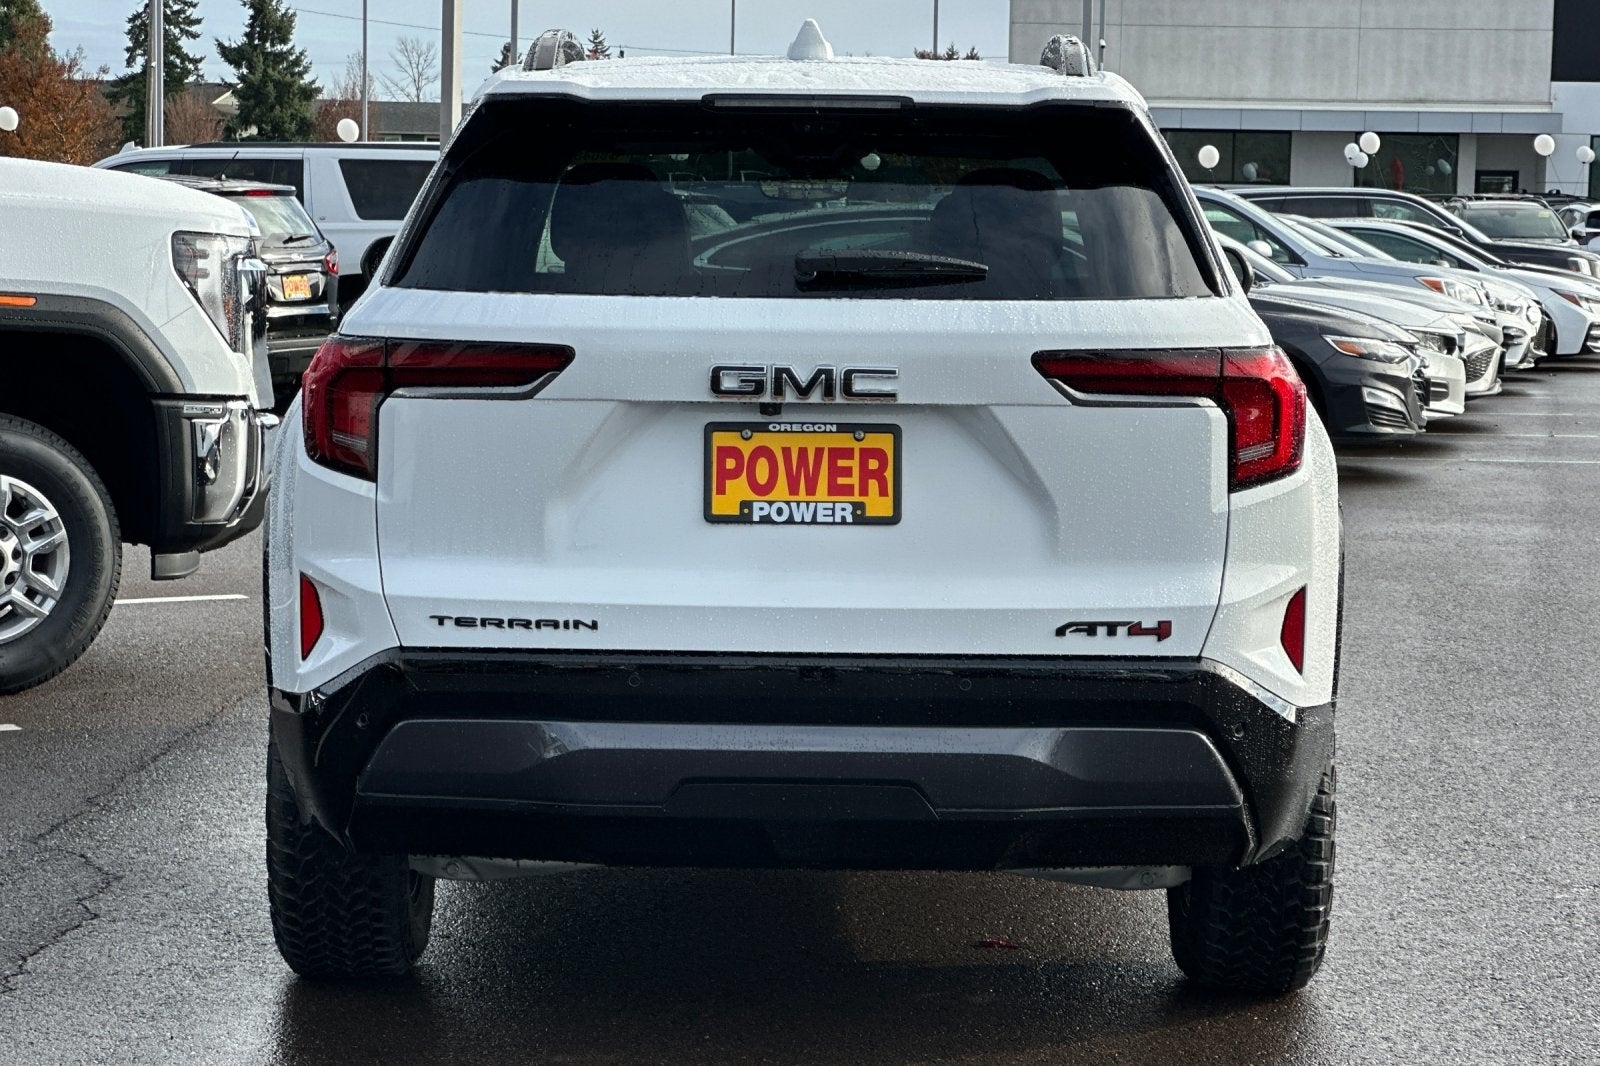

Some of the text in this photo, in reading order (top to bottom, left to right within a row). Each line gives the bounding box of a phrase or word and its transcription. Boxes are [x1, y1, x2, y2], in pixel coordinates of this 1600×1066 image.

[284, 279, 308, 292] POWER
[709, 364, 899, 401] GMC
[768, 424, 837, 432] OREGON
[715, 445, 889, 497] POWER
[752, 502, 853, 523] POWER
[429, 615, 599, 631] TERRAIN
[1055, 620, 1172, 641] AT4
